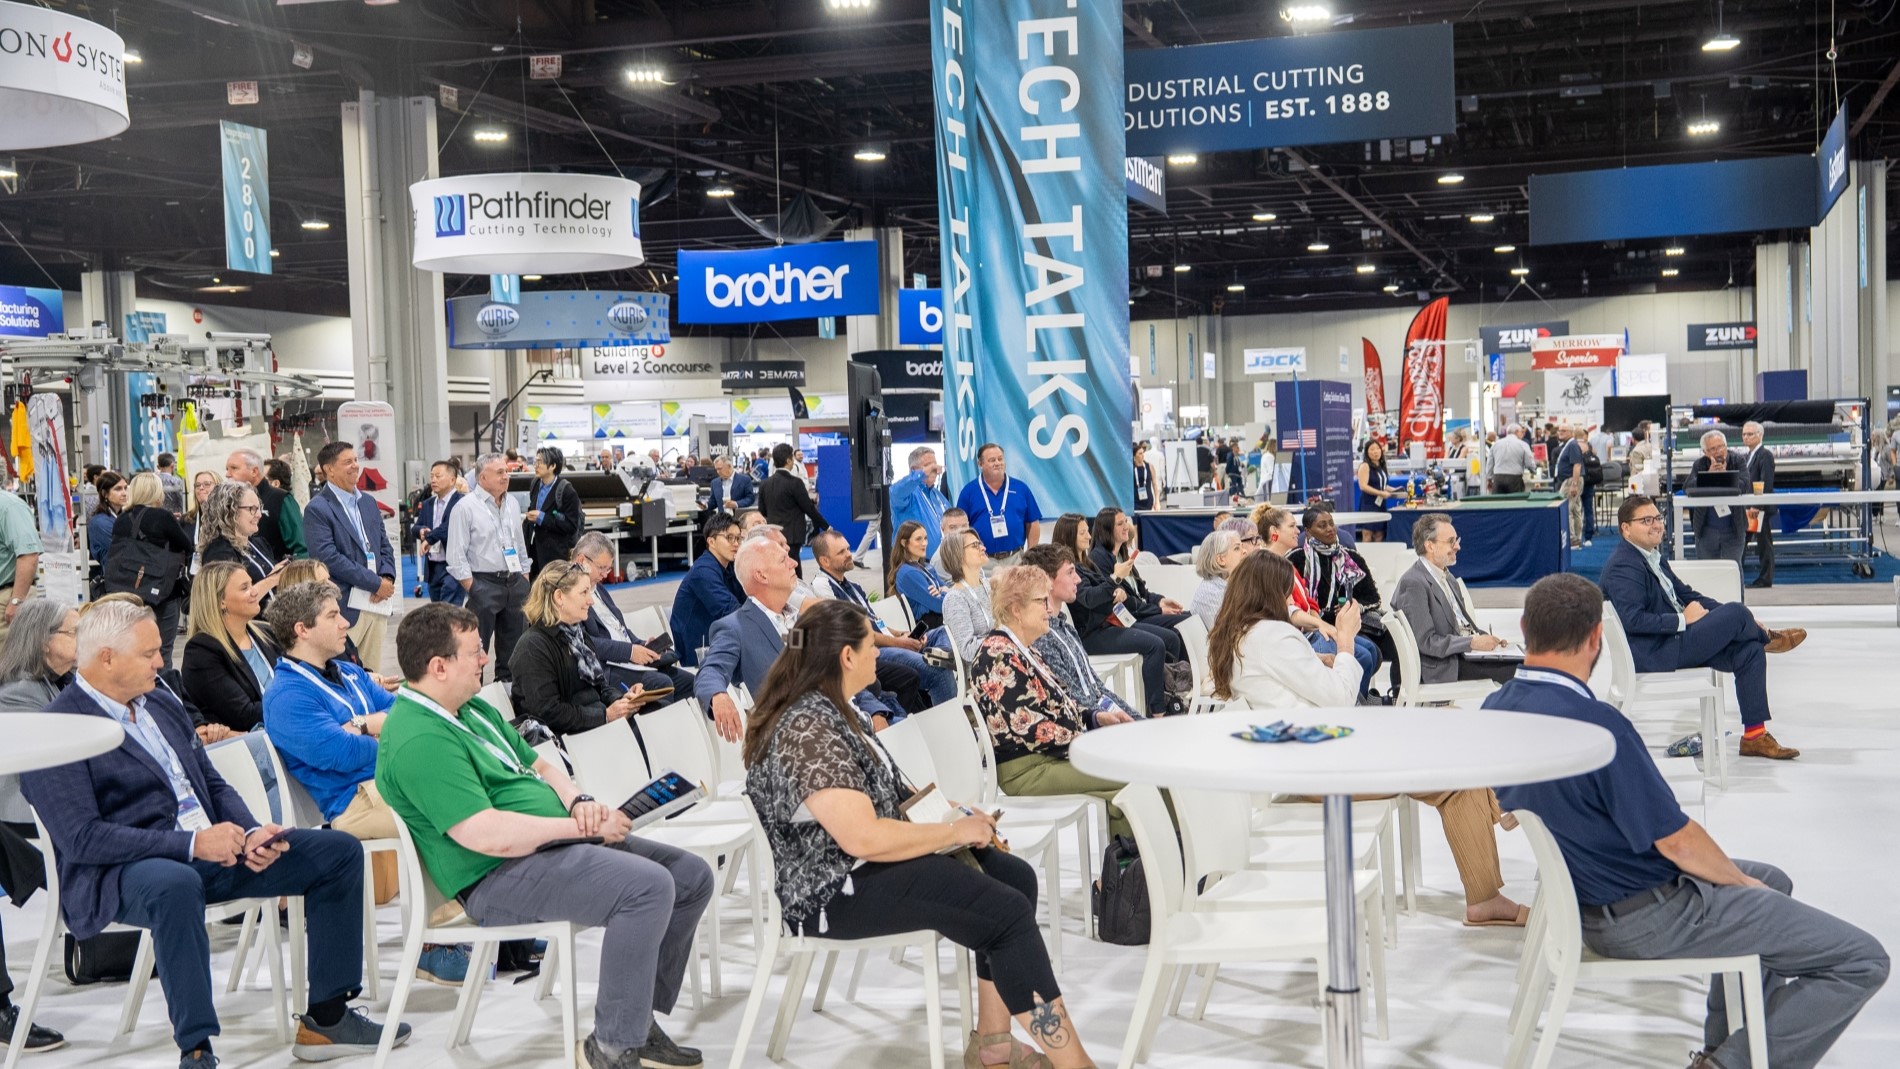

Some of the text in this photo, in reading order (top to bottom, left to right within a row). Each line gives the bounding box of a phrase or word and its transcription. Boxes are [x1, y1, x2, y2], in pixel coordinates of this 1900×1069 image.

[536, 57, 556, 65] FIRE
[232, 82, 253, 90] FIRE
[1253, 64, 1364, 92] CUTTING
[1265, 97, 1316, 120] EST.
[1325, 91, 1391, 115] 1888
[241, 156, 255, 259] 2800
[468, 191, 611, 221] Pathfinder
[470, 222, 612, 238] Cutting Technology
[943, 0, 976, 462] ECH TALKS
[1018, 0, 1089, 460] ECH TALKS
[705, 262, 849, 308] brother
[0, 314, 40, 328] Solutions
[481, 308, 515, 327] KURIS
[613, 306, 644, 325] KURIS
[1553, 339, 1600, 349] MERROW
[594, 360, 713, 375] Level 2 Concourse
[1247, 354, 1301, 367] JACK
[1556, 352, 1599, 367] Superior
